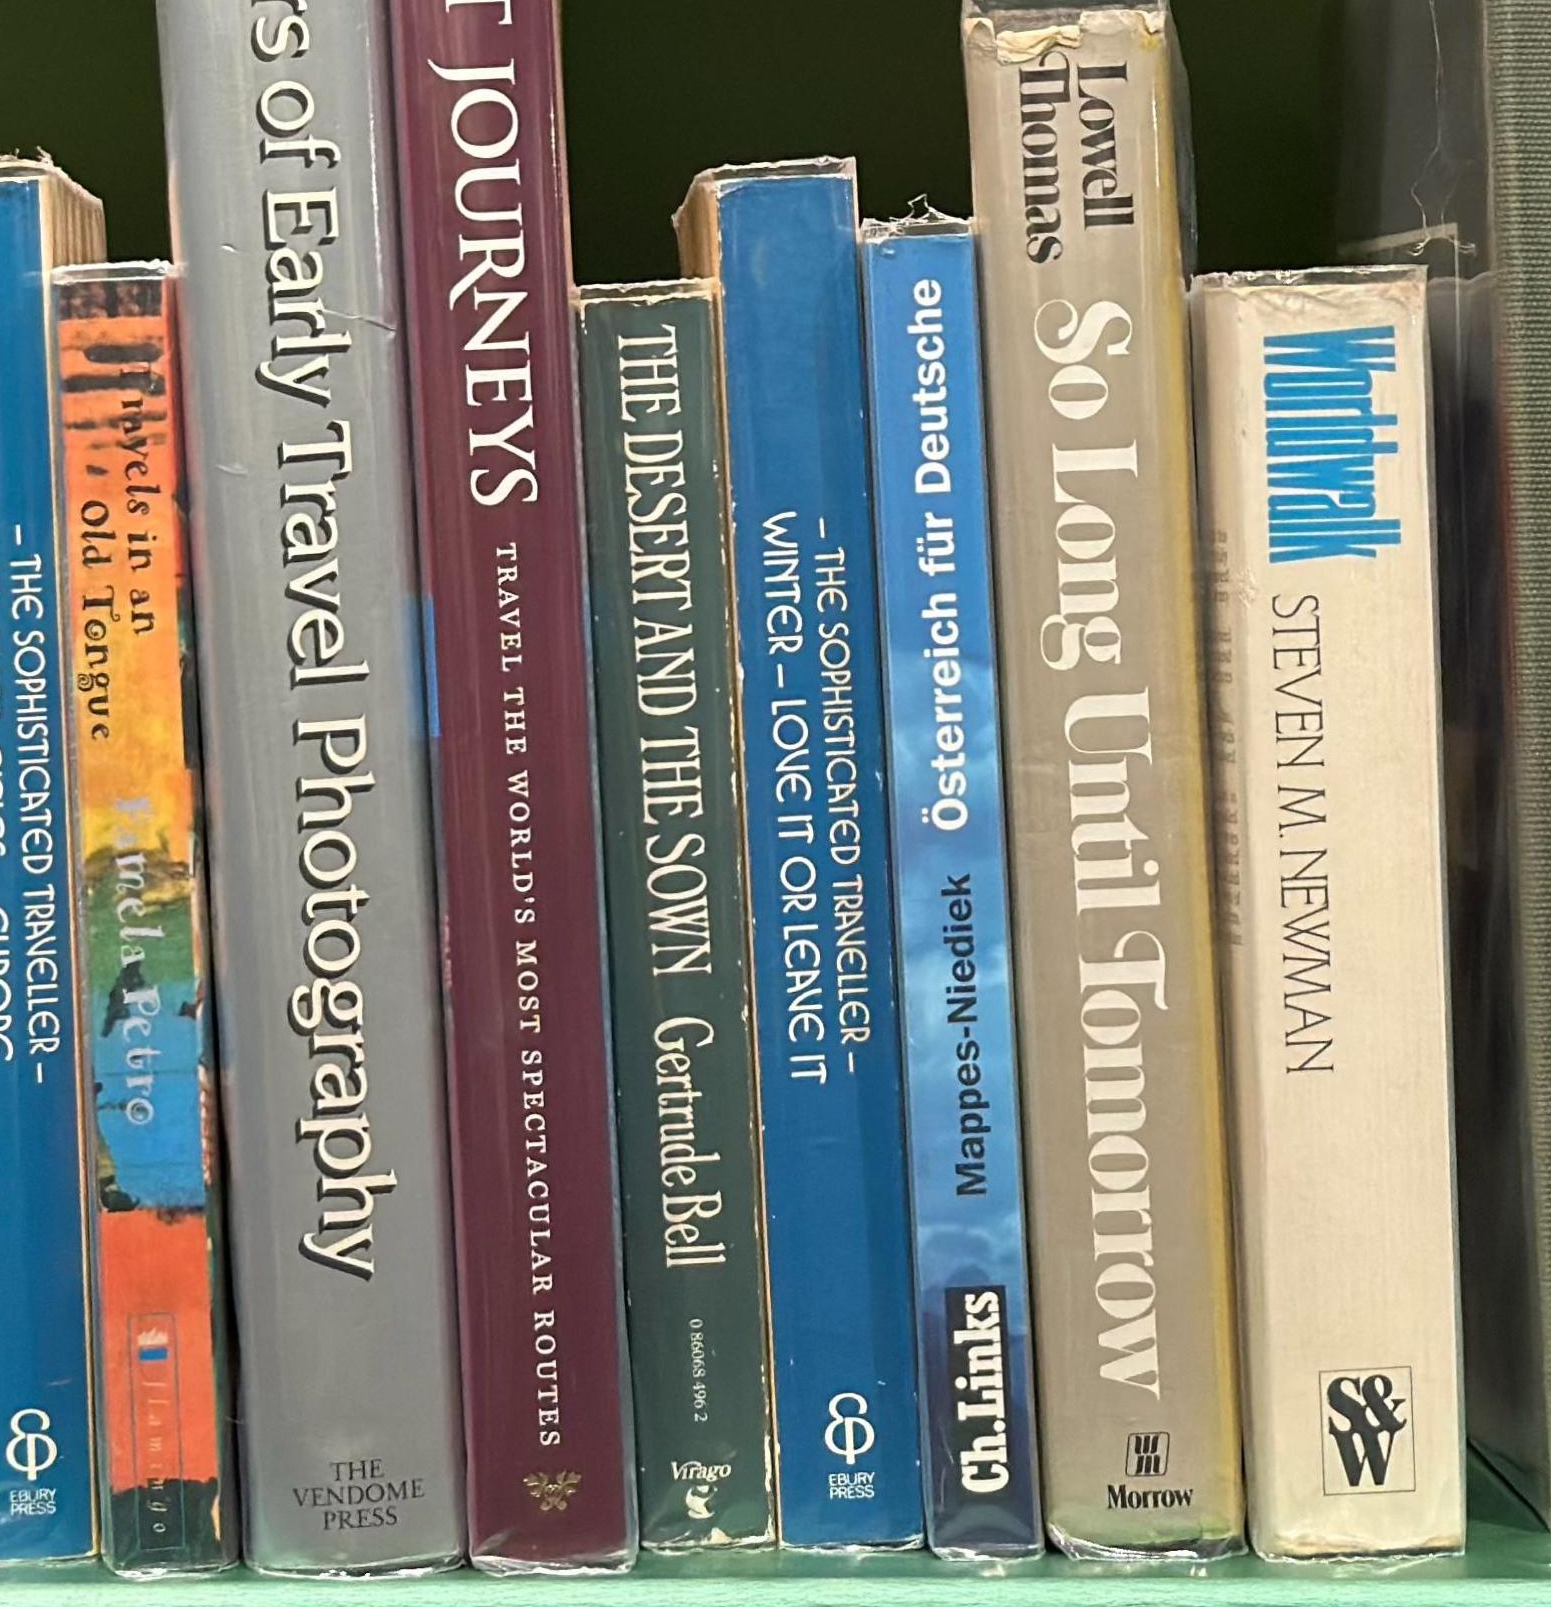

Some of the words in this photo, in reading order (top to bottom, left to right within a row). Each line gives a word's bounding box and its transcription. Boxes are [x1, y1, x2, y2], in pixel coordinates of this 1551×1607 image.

[255, 80, 341, 168] of
[1019, 48, 1071, 265] Thomas
[1076, 62, 1135, 231] Lowell
[255, 189, 352, 407] Early
[427, 59, 539, 507] JOURNEYS
[616, 325, 683, 424] THE
[906, 278, 952, 494] Deutsche
[1033, 299, 1135, 421] So
[1262, 324, 1402, 564] Worldwalk
[78, 500, 114, 566] Old
[126, 532, 153, 573] in
[276, 420, 369, 690] Travel
[621, 431, 695, 609] DESERT
[763, 511, 803, 655] WINTER
[814, 546, 848, 613] THE
[919, 512, 956, 575] für
[1039, 440, 1139, 672] Long
[9, 553, 44, 620] THE
[130, 589, 155, 634] an
[495, 542, 523, 673] TRAVEL
[77, 586, 122, 739] Tongue
[503, 686, 528, 755] THE
[634, 614, 698, 717] AND
[921, 592, 968, 832] Österreich
[1271, 595, 1326, 774] STEVEN
[13, 630, 54, 874] SOPHISTICATED
[640, 725, 704, 825] THE
[771, 699, 812, 803] LOVE
[818, 622, 861, 865] SOPHISTICATED
[1064, 686, 1161, 914] Until
[506, 770, 537, 925] WORLD'S
[777, 814, 814, 844] IT
[1277, 783, 1327, 838] M.
[643, 830, 713, 977] SOWN
[780, 856, 817, 913] OR
[23, 884, 60, 1055] TRAVELLER
[288, 716, 398, 1282] Photography
[515, 940, 542, 1033] MOST
[783, 924, 825, 1042] LEAVE
[832, 874, 871, 1045] TRAVELLER
[1280, 850, 1336, 1075] NEWMAN
[122, 985, 161, 1125] Petro
[789, 1054, 827, 1085] IT
[941, 874, 994, 1196] Mappes-Niediek
[653, 1016, 720, 1186] Gertrude
[520, 1049, 556, 1296] SPECTACULAR
[1079, 929, 1169, 1401] Tomorrow
[662, 1192, 727, 1270] Bell
[532, 1311, 562, 1448] ROUTES
[10, 1488, 57, 1502] EBURY
[10, 1502, 57, 1516] PRESS
[292, 1478, 425, 1507] VENDOME
[324, 1506, 398, 1530] PRESS
[330, 1459, 385, 1481] THE
[670, 1461, 732, 1482] Virago
[828, 1472, 875, 1486] EBURY
[829, 1485, 875, 1499] PRESS
[1107, 1484, 1193, 1509] Morrow
